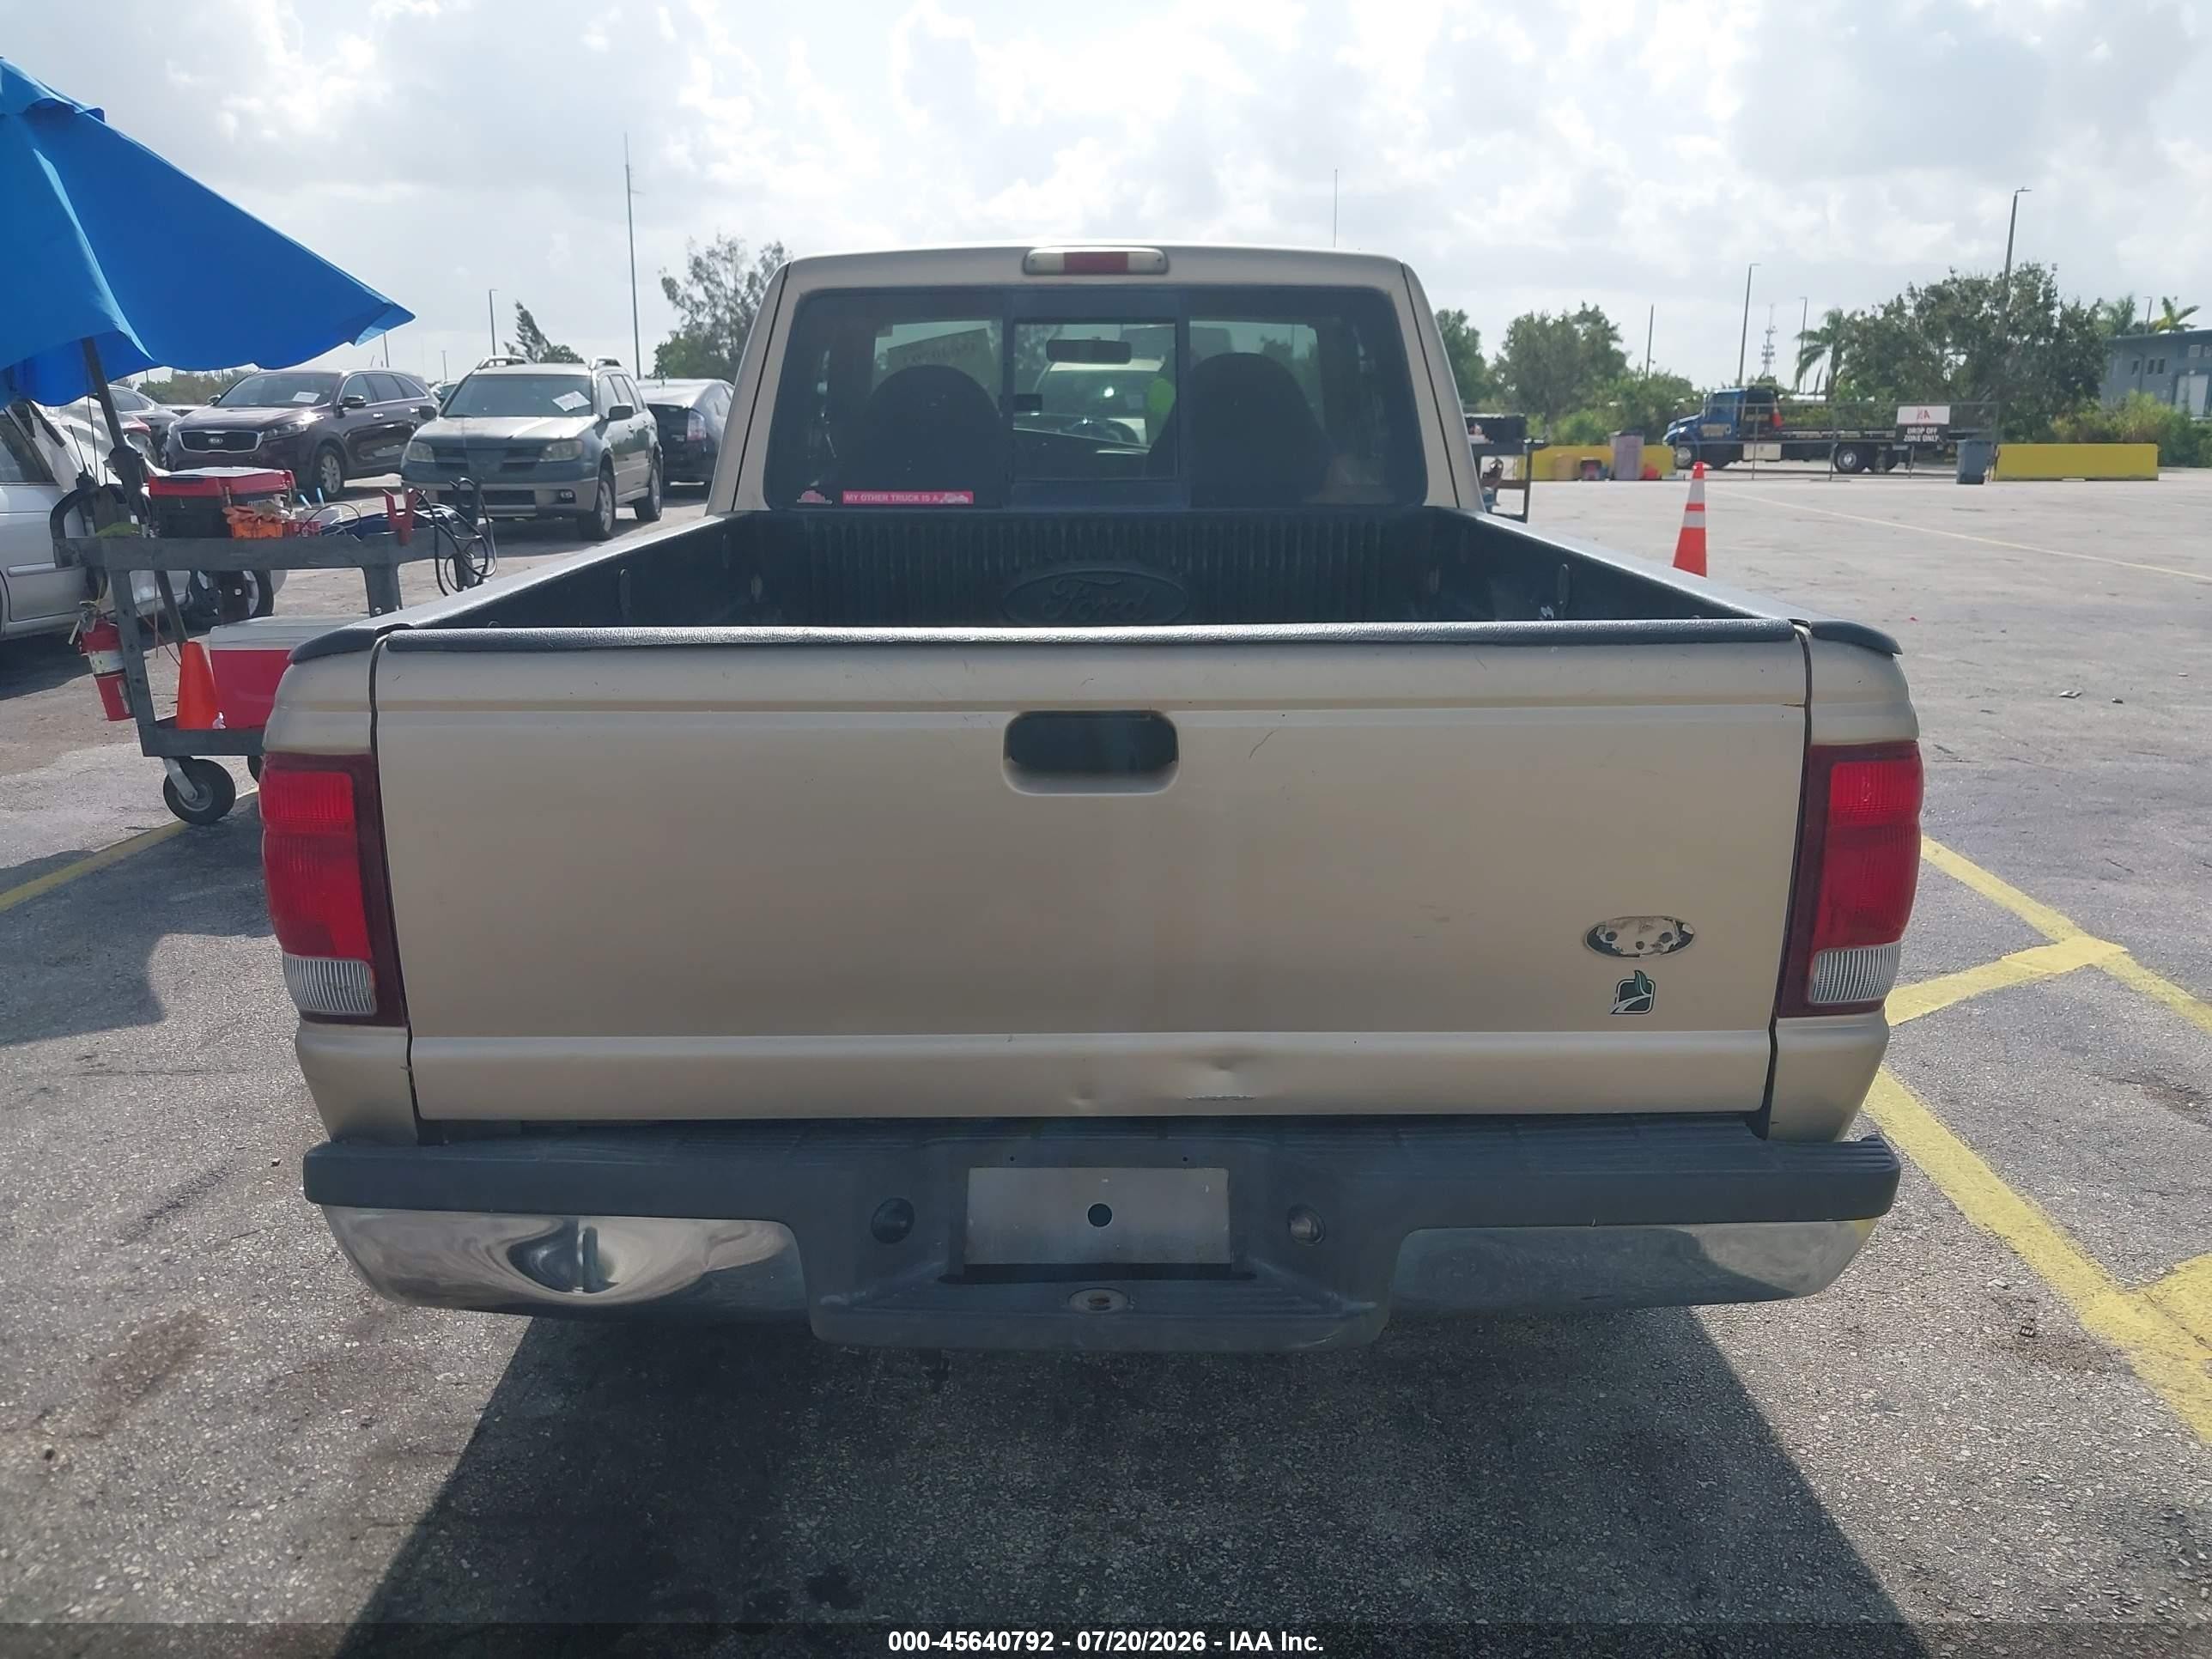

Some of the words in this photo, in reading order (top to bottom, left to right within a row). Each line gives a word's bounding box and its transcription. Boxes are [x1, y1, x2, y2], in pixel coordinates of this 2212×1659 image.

[845, 493, 859, 502] MY
[860, 493, 888, 502] OTHER
[891, 493, 920, 502] TRUCK
[921, 493, 931, 502] IS
[933, 493, 939, 502] A
[1041, 578, 1151, 620] Ford
